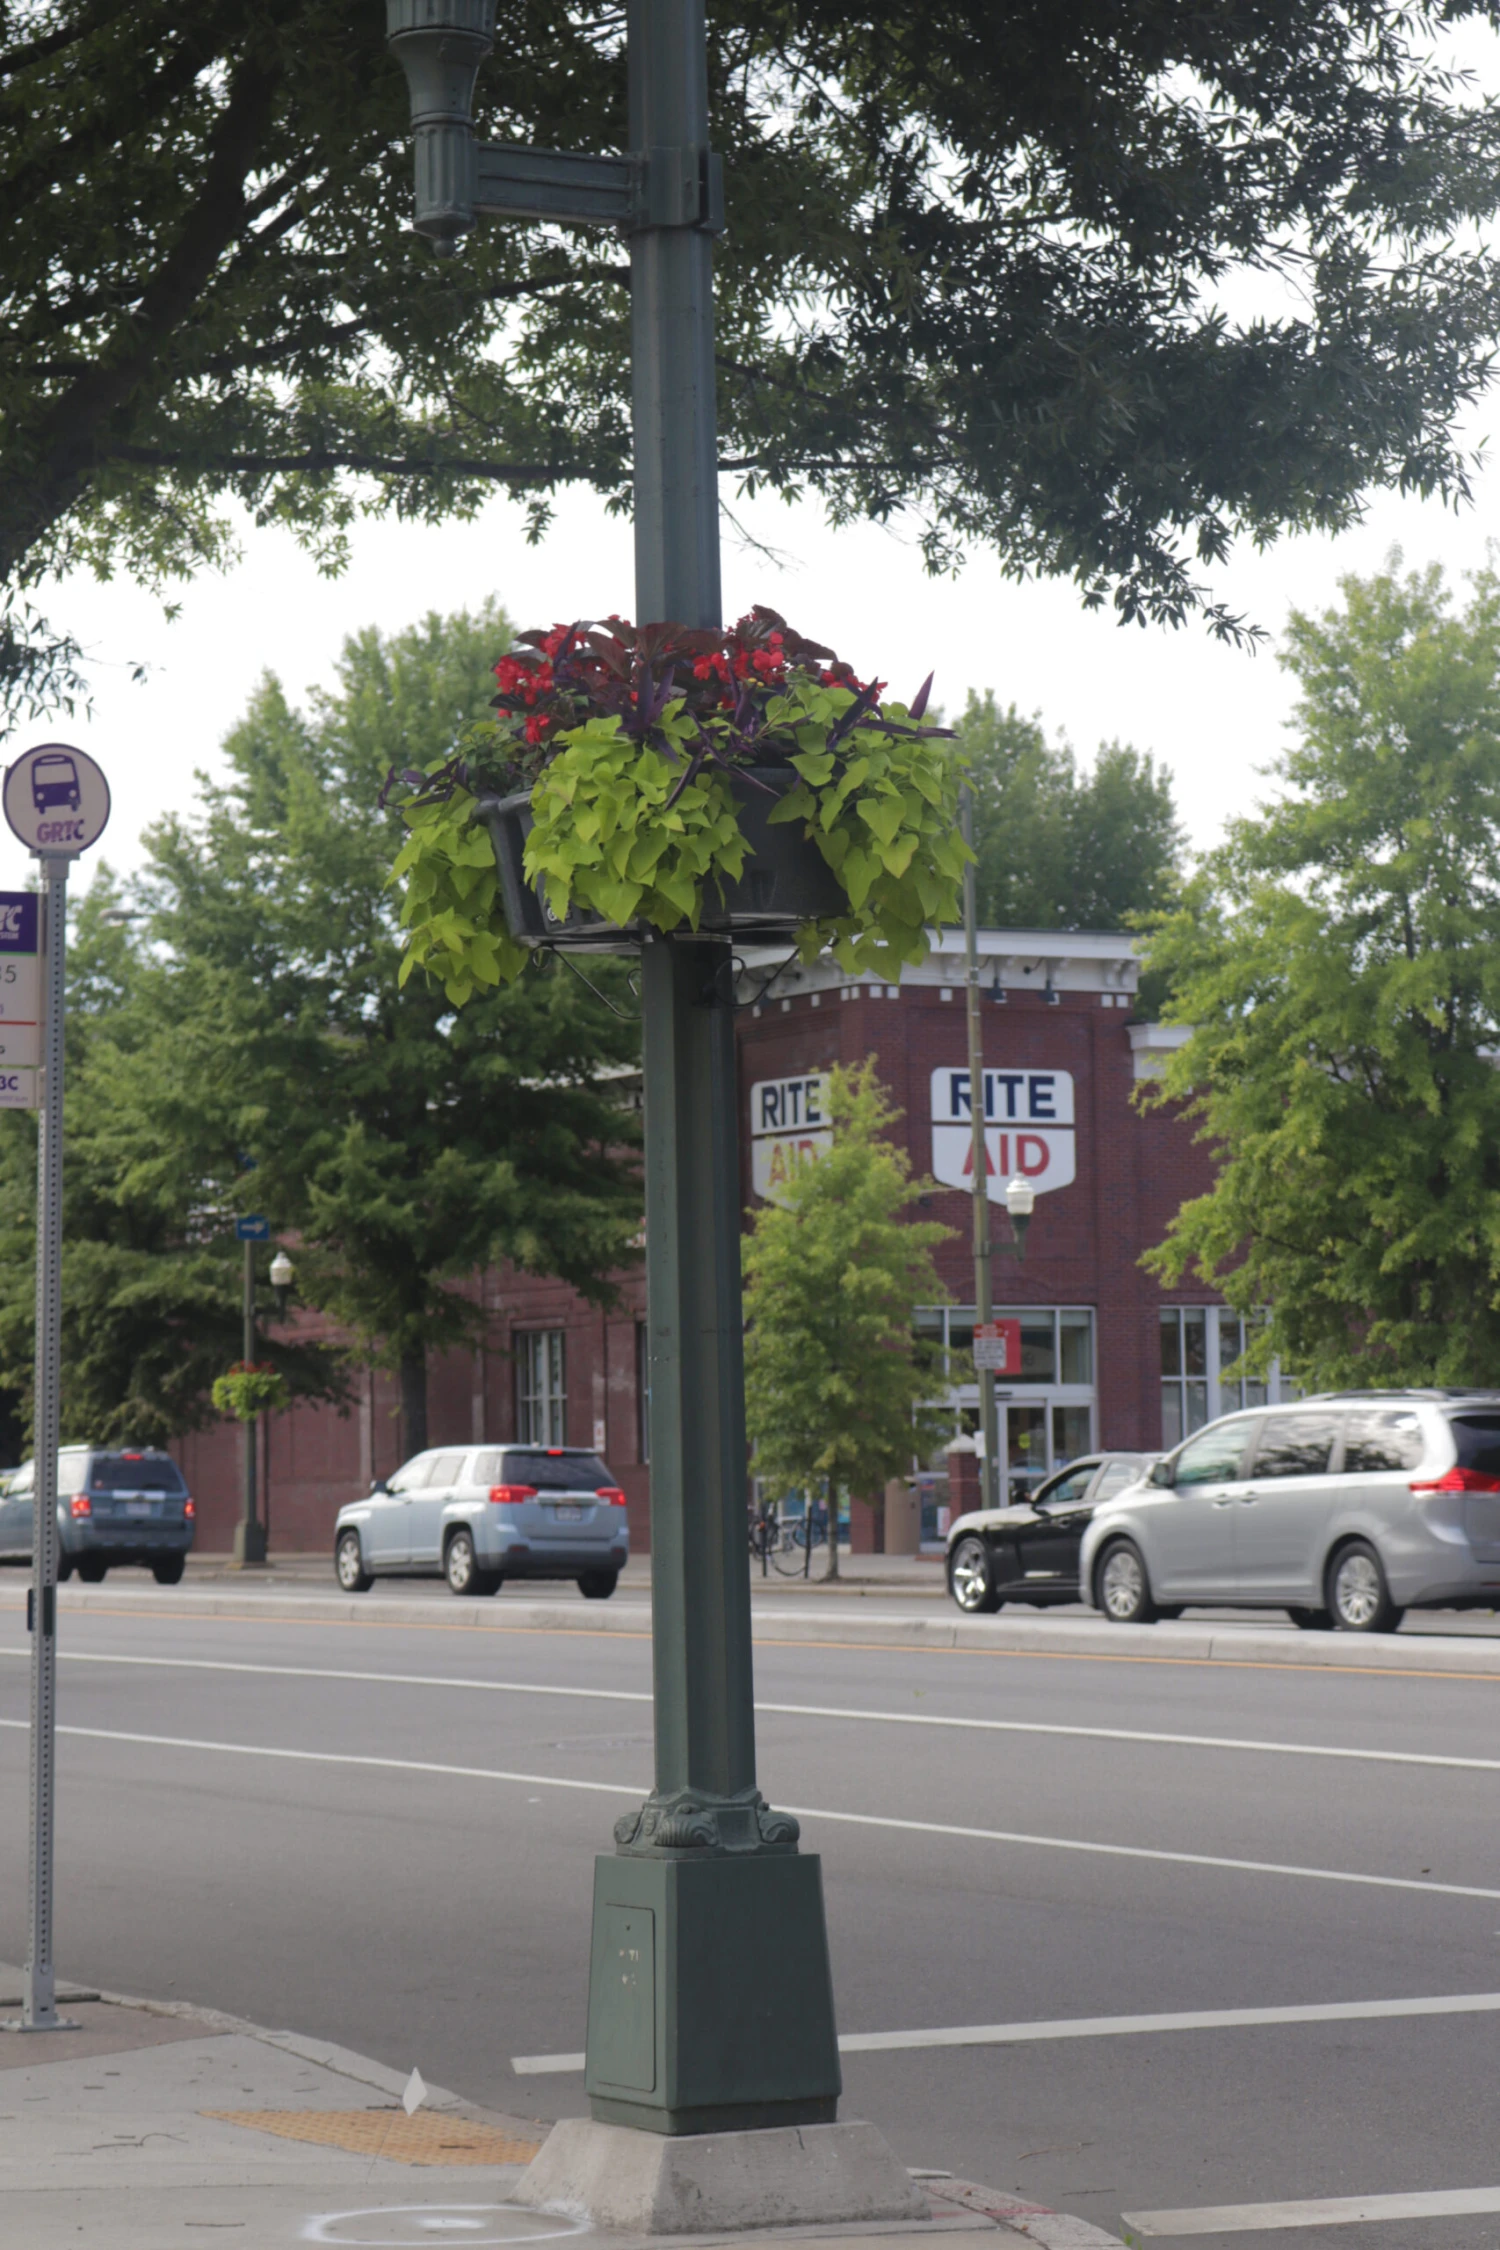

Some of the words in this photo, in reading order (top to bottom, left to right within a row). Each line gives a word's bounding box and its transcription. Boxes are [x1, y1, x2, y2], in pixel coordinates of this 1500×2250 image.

[37, 818, 84, 843] GRTC
[762, 1081, 820, 1128] RITE
[949, 1073, 1056, 1118] RITE
[963, 1133, 1050, 1177] AID
